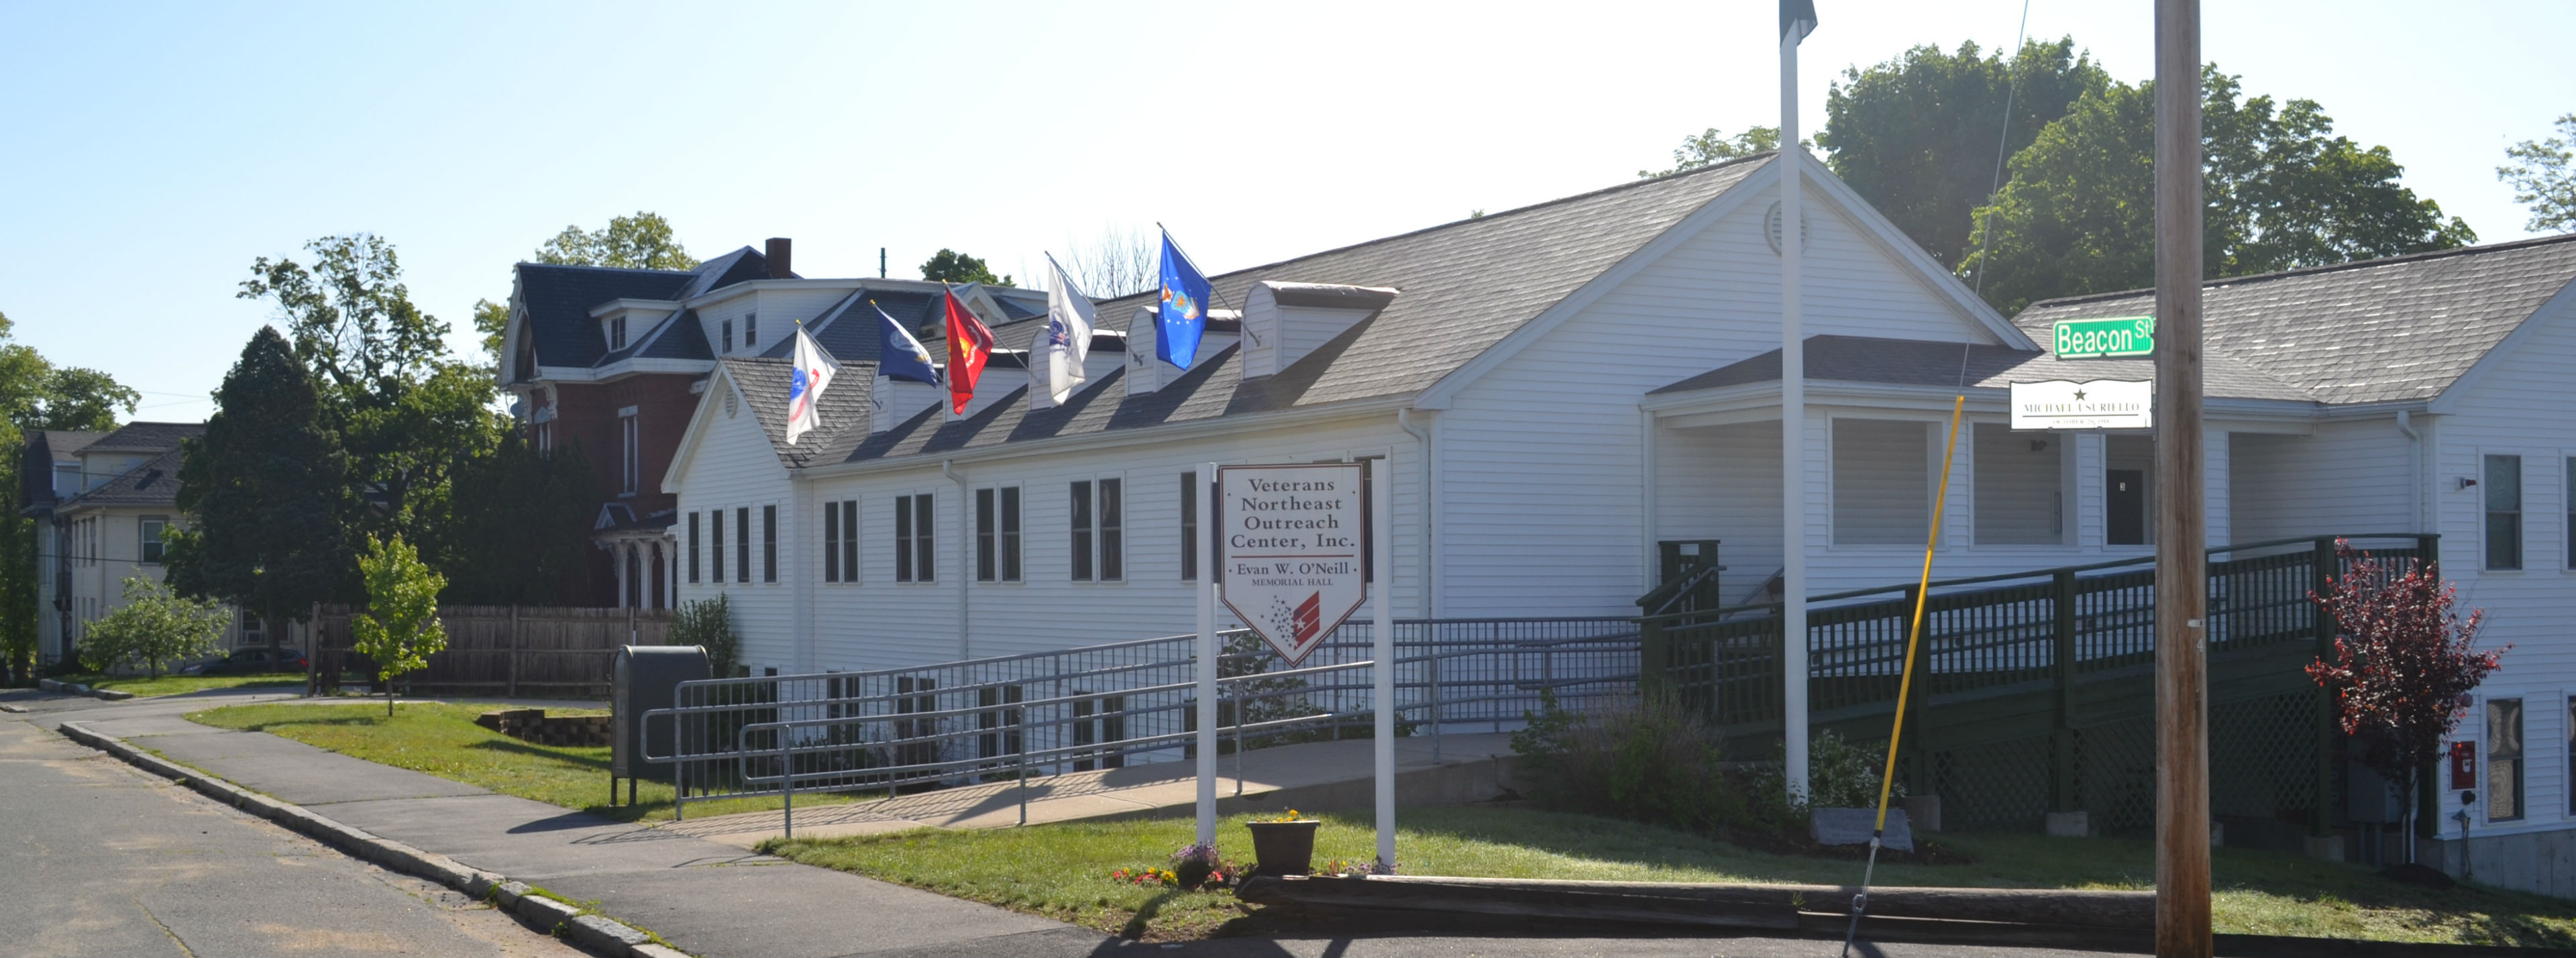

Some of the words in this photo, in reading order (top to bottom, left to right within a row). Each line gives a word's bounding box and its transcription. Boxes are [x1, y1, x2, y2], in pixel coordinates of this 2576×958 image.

[2057, 324, 2132, 353] Beacon
[2135, 320, 2150, 339] St
[2024, 403, 2073, 413] MICHAEL
[2078, 403, 2139, 413] USURIELLO
[1248, 478, 1335, 492] Veterans
[1240, 496, 1342, 511] Northeast
[1244, 514, 1339, 530] Outreach
[1230, 534, 1306, 550] Center,
[1316, 533, 1355, 547] Inc.
[1237, 563, 1269, 575] Evan
[1274, 562, 1294, 575] W.
[1299, 562, 1349, 575] O'Neill
[1252, 578, 1304, 586] MEMORIAL
[1307, 578, 1334, 586] HALL
